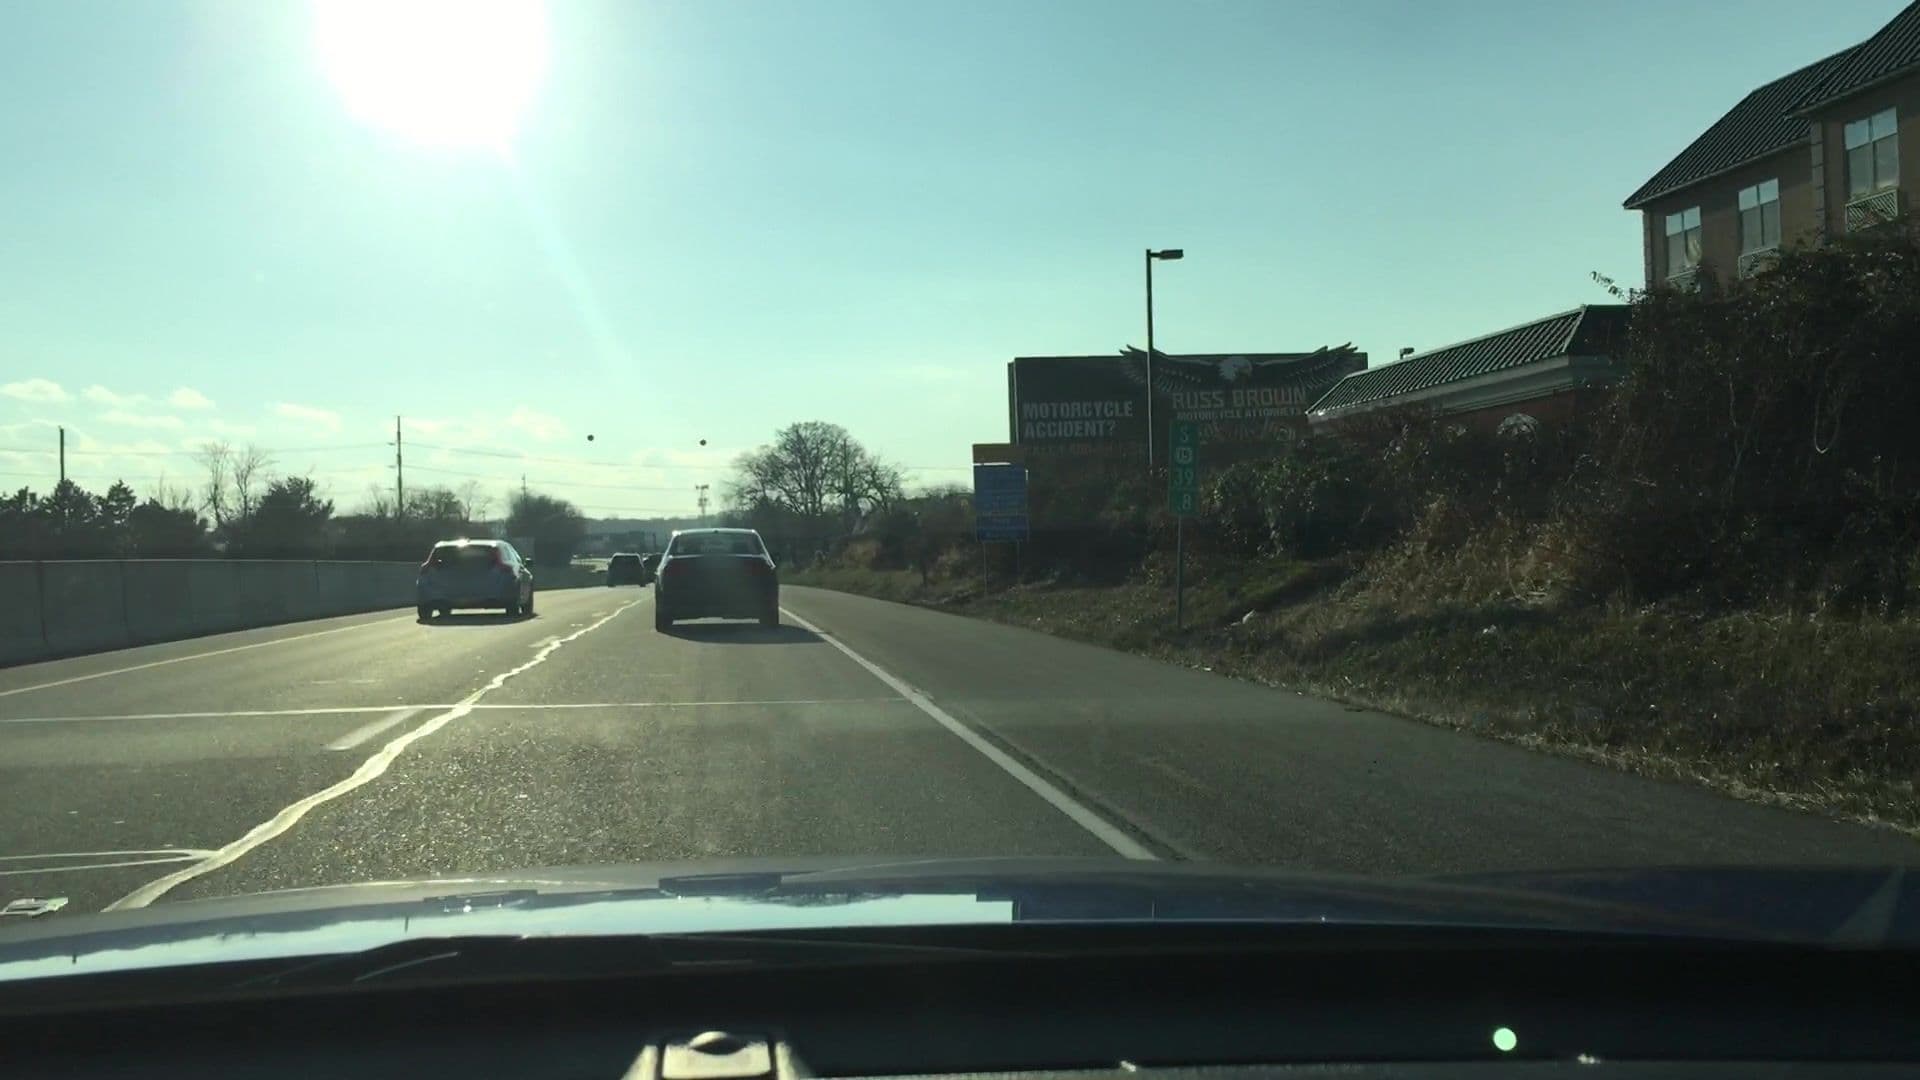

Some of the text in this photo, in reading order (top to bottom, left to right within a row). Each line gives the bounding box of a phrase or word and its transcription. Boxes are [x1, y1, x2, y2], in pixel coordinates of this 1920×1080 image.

[1172, 386, 1307, 409] RUSS BROWN
[1022, 400, 1133, 420] MOTORCYCLE
[1023, 419, 1117, 438] ACCIDENT?
